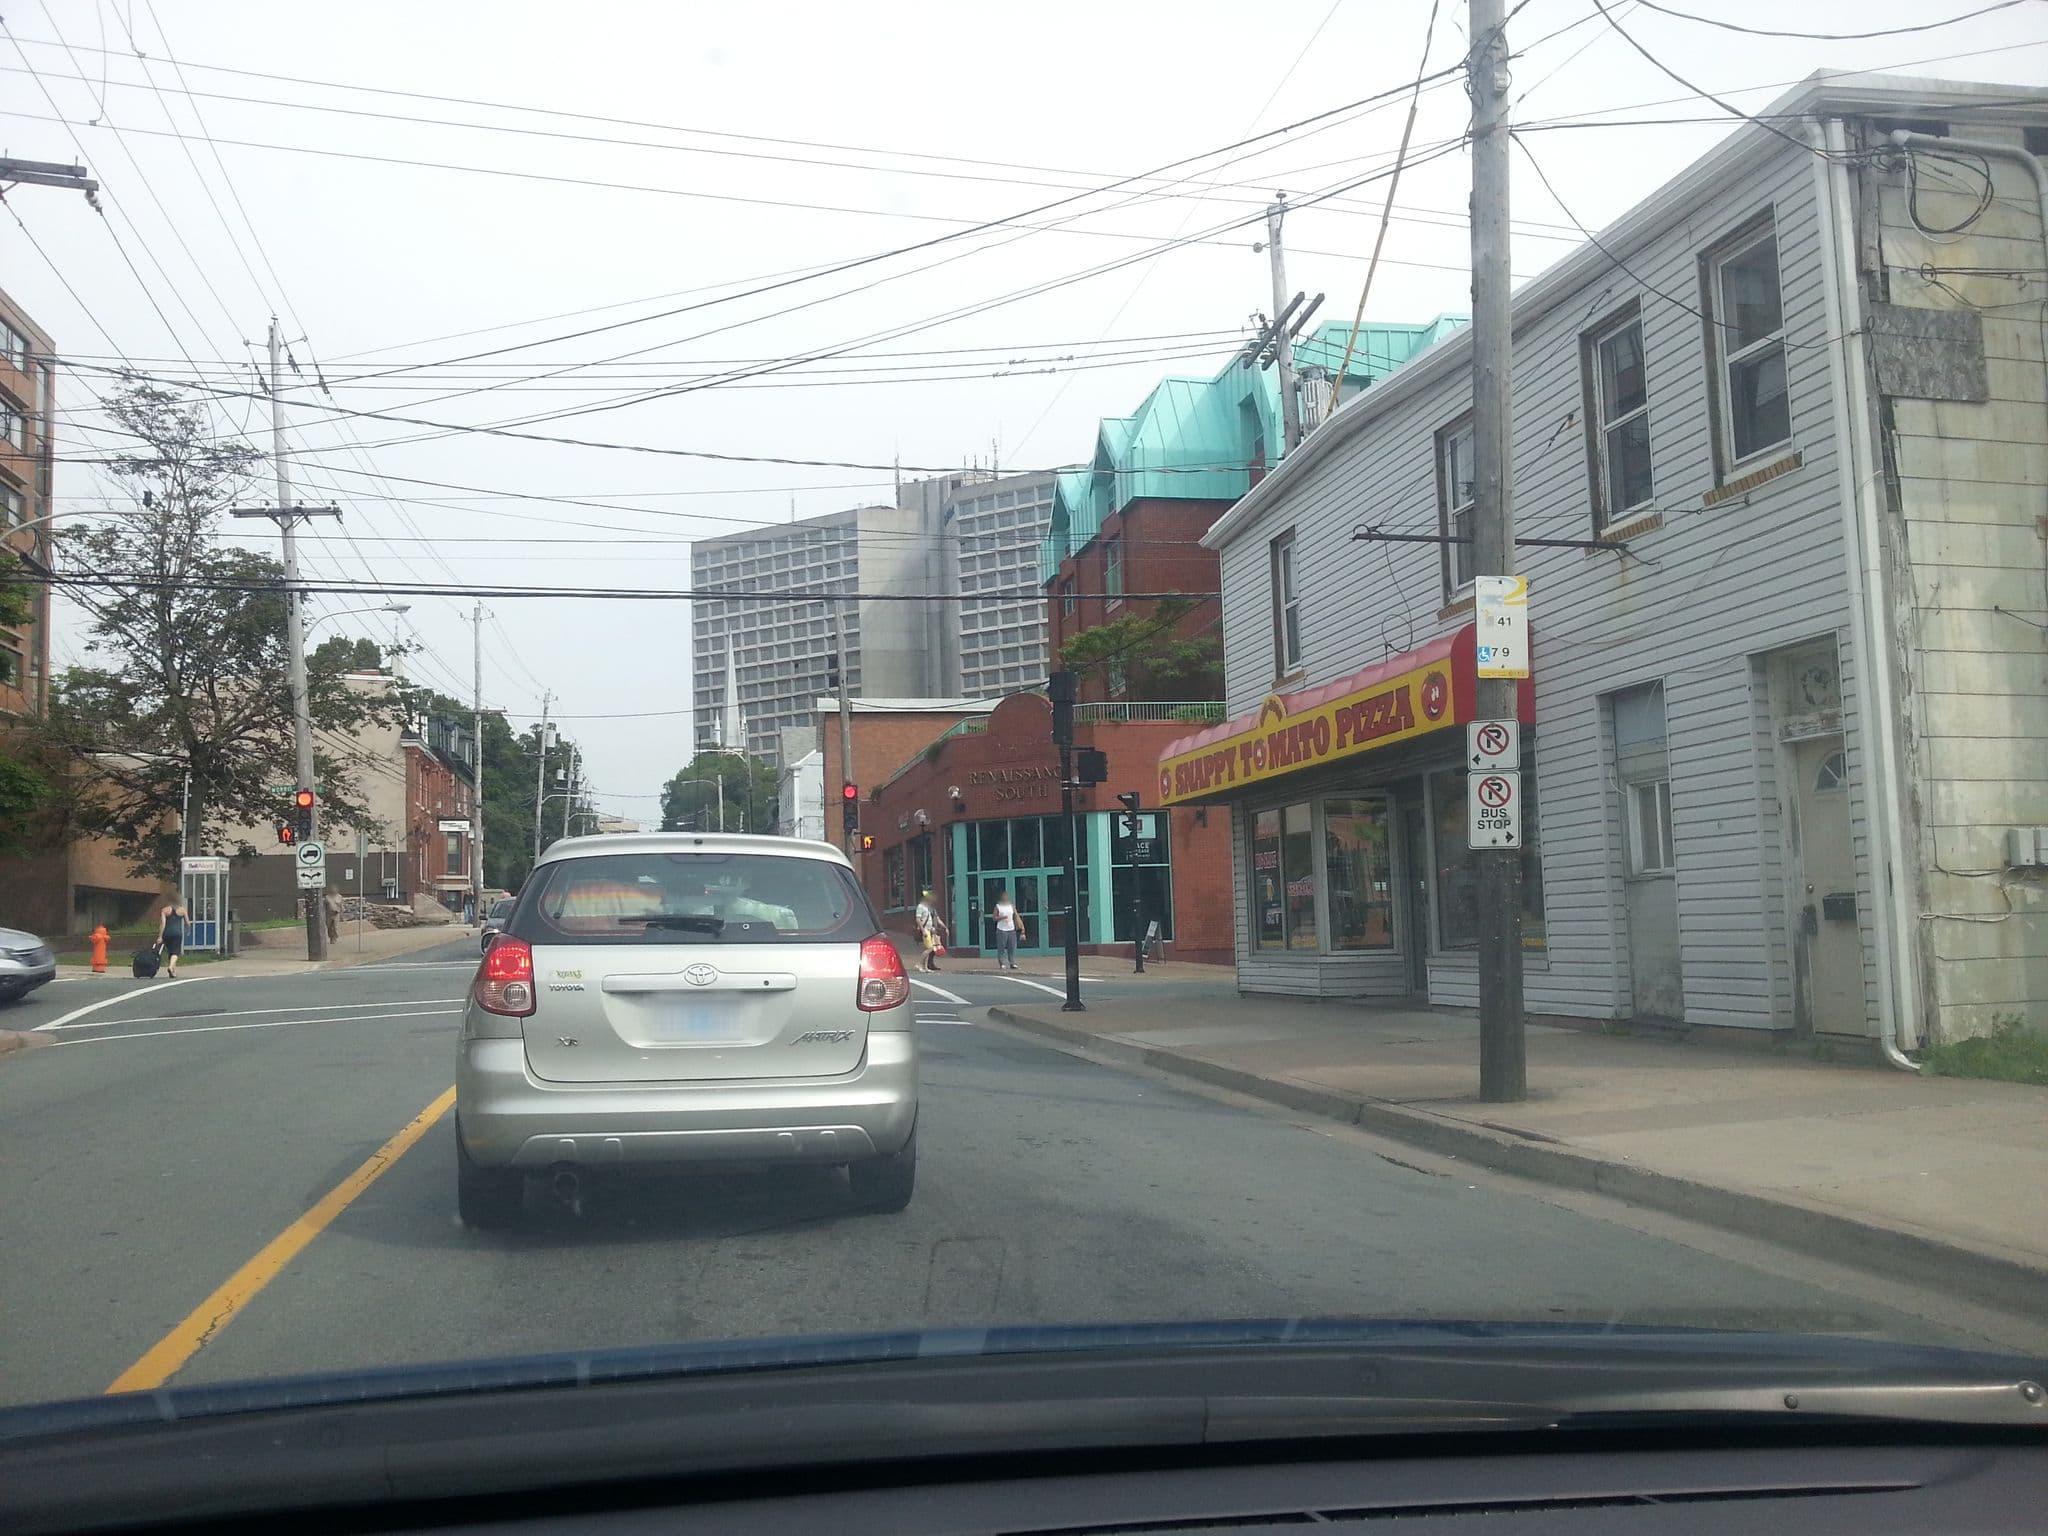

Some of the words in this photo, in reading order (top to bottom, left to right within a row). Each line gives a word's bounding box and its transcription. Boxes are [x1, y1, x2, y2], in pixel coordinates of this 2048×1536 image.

[1497, 616, 1512, 627] 41
[1175, 746, 1237, 796] SNAPPY
[1240, 715, 1331, 777] TOMATO
[1335, 684, 1415, 750] PIZZA
[968, 765, 1061, 785] RENAISSANC
[994, 783, 1048, 800] SOUTH
[1481, 808, 1508, 818] BUS
[1477, 819, 1511, 830] STOP
